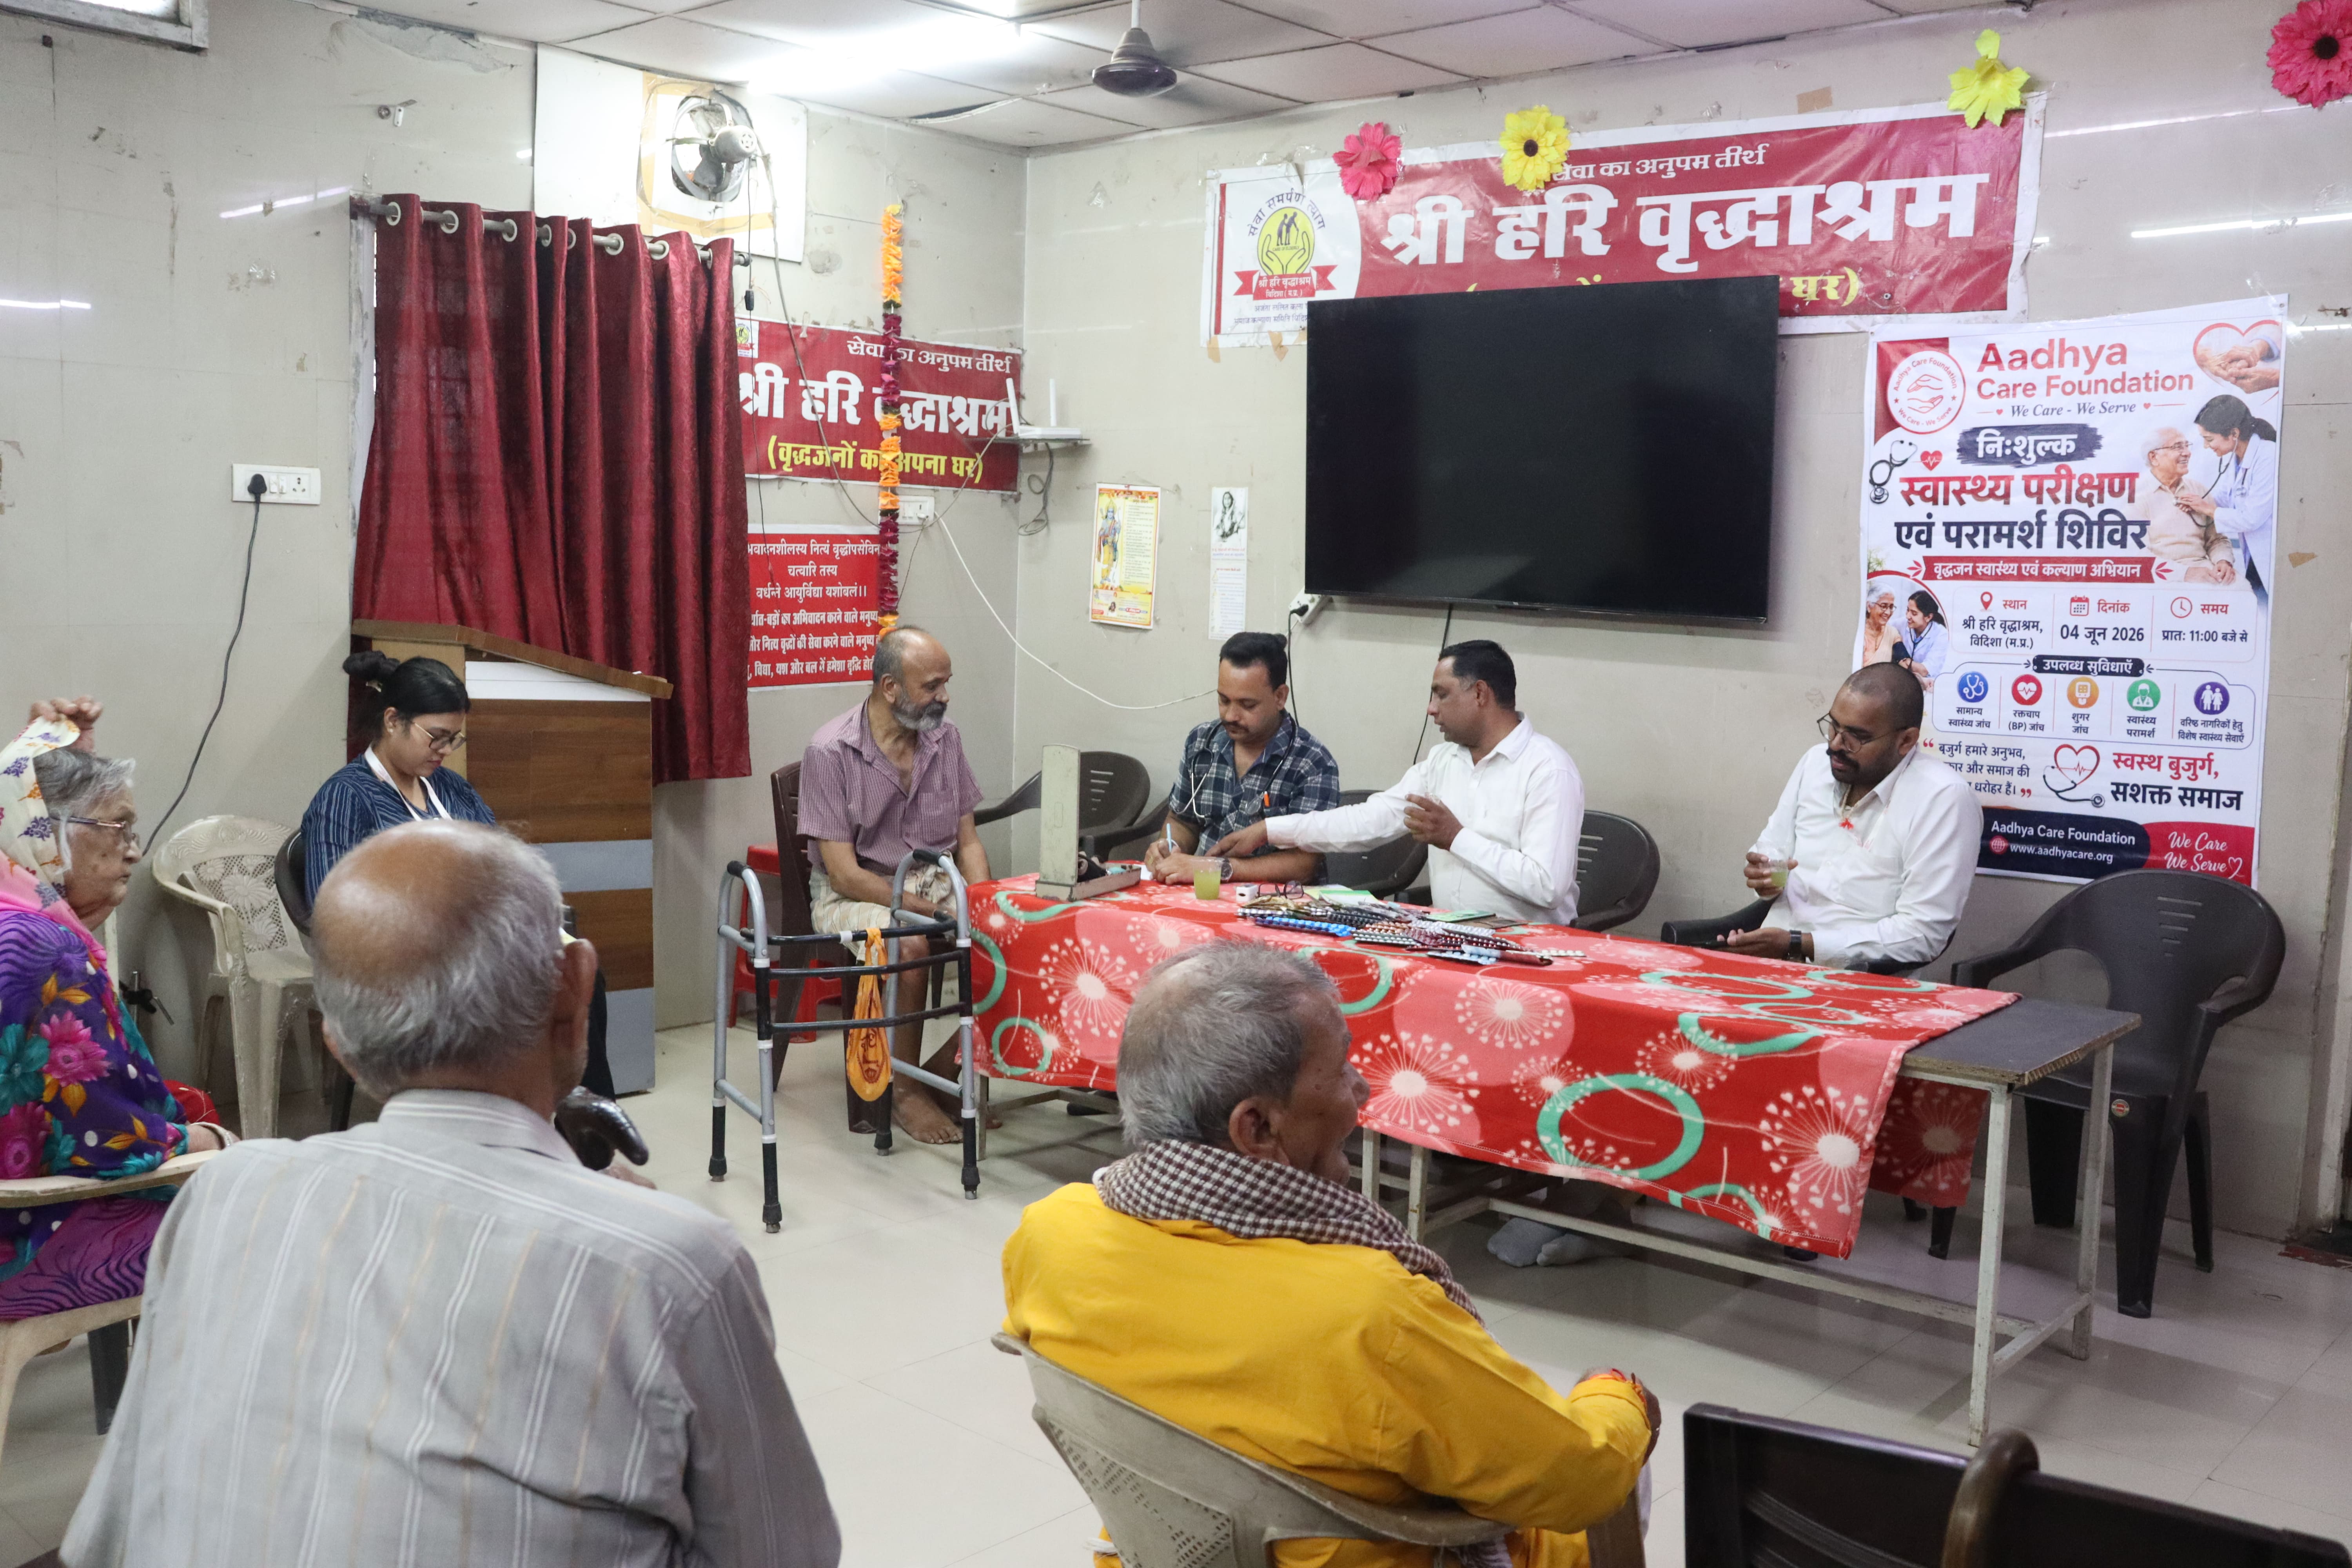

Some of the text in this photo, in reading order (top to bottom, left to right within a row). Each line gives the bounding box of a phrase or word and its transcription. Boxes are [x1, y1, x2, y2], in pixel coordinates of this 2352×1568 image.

[1600, 161, 1631, 176] का
[1635, 154, 1711, 178] अनुपम
[1715, 143, 1769, 169] तीर्थ
[1247, 208, 1266, 236] सेवा
[1265, 187, 1307, 209] समर्पण
[1380, 173, 1990, 273] श्री हरि वृद्धाश्रम
[1259, 276, 1311, 289] श्री हरि वृद्धाश्रम
[1789, 266, 1860, 307] घर)
[847, 335, 886, 358] सेवा
[918, 350, 973, 372] अनुपम
[975, 353, 1013, 373] तीर्थ
[1976, 338, 2127, 376] Aadhya
[1893, 358, 1957, 391] Aadhya Care Foundation
[739, 362, 789, 418] श्री
[799, 370, 864, 425] हरि
[1977, 369, 2194, 400] Care Foundation
[1898, 408, 1907, 418] We
[1907, 416, 1920, 426] Care
[2011, 405, 2029, 417] We
[2033, 403, 2063, 416] Care
[2077, 403, 2095, 415] We
[2098, 401, 2136, 414] Serve
[768, 435, 858, 472] (वृद्धजनों
[1976, 428, 2078, 465] निःशुल्क
[1900, 463, 2140, 508] स्वास्थ्य परीक्षण
[1894, 508, 2151, 550] एवं परामर्श शिविर
[810, 539, 830, 555] नित्यं
[788, 560, 838, 577] चत्वारि तस्य
[1933, 563, 1973, 580] वृद्धजन
[2022, 560, 2039, 576] एवं
[2042, 563, 2087, 577] कल्याण
[2002, 599, 2027, 610] स्थान
[2097, 599, 2131, 613] दिनांक
[2200, 603, 2229, 615] समय
[781, 613, 791, 626] का
[793, 609, 826, 625] अभिवादन
[827, 608, 843, 624] करने
[844, 607, 858, 623] वाले
[1962, 616, 2043, 635] श्री हरि वृद्धाश्रम,
[762, 635, 779, 651] नित्य
[808, 633, 822, 649] सेवा
[823, 632, 839, 648] करने
[840, 632, 855, 648] वाले
[1970, 634, 2002, 648] विदिशा
[2060, 624, 2145, 645] 04 जून 2026
[2189, 630, 2218, 642] 11:00
[2221, 628, 2237, 643] बजे
[2239, 629, 2248, 643] से
[790, 658, 804, 675] और
[805, 661, 818, 674] बल
[826, 657, 846, 673] हमेशा
[2043, 659, 2084, 671] उपलब्ध
[1956, 706, 1983, 715] सामान्य
[2013, 710, 2040, 719] रक्तचाप
[2072, 713, 2090, 723] शुगर
[1975, 719, 1991, 728] जांच
[2008, 721, 2045, 732] (BP) जांच
[2072, 724, 2089, 734] जांच
[2180, 717, 2243, 733] वरिष्ठ नागरिकों हेतु
[2127, 728, 2156, 739] परामर्श
[2178, 729, 2197, 740] विशेष
[1965, 743, 1988, 756] हमारे
[1991, 746, 2025, 761] अनुभव,
[1966, 760, 1984, 774] और
[1986, 765, 2014, 777] समाज
[2017, 764, 2030, 777] की
[2112, 752, 2219, 782] स्वस्थ बुजुर्ग,
[1975, 779, 2003, 795] धरोहर
[2110, 782, 2244, 811] सशक्त समाज
[1991, 820, 2136, 846] Aadhya Care Foundation
[2168, 831, 2228, 852] We Care
[2010, 844, 2114, 864] www.aadhyacare.org
[2164, 851, 2227, 873] We Serve
